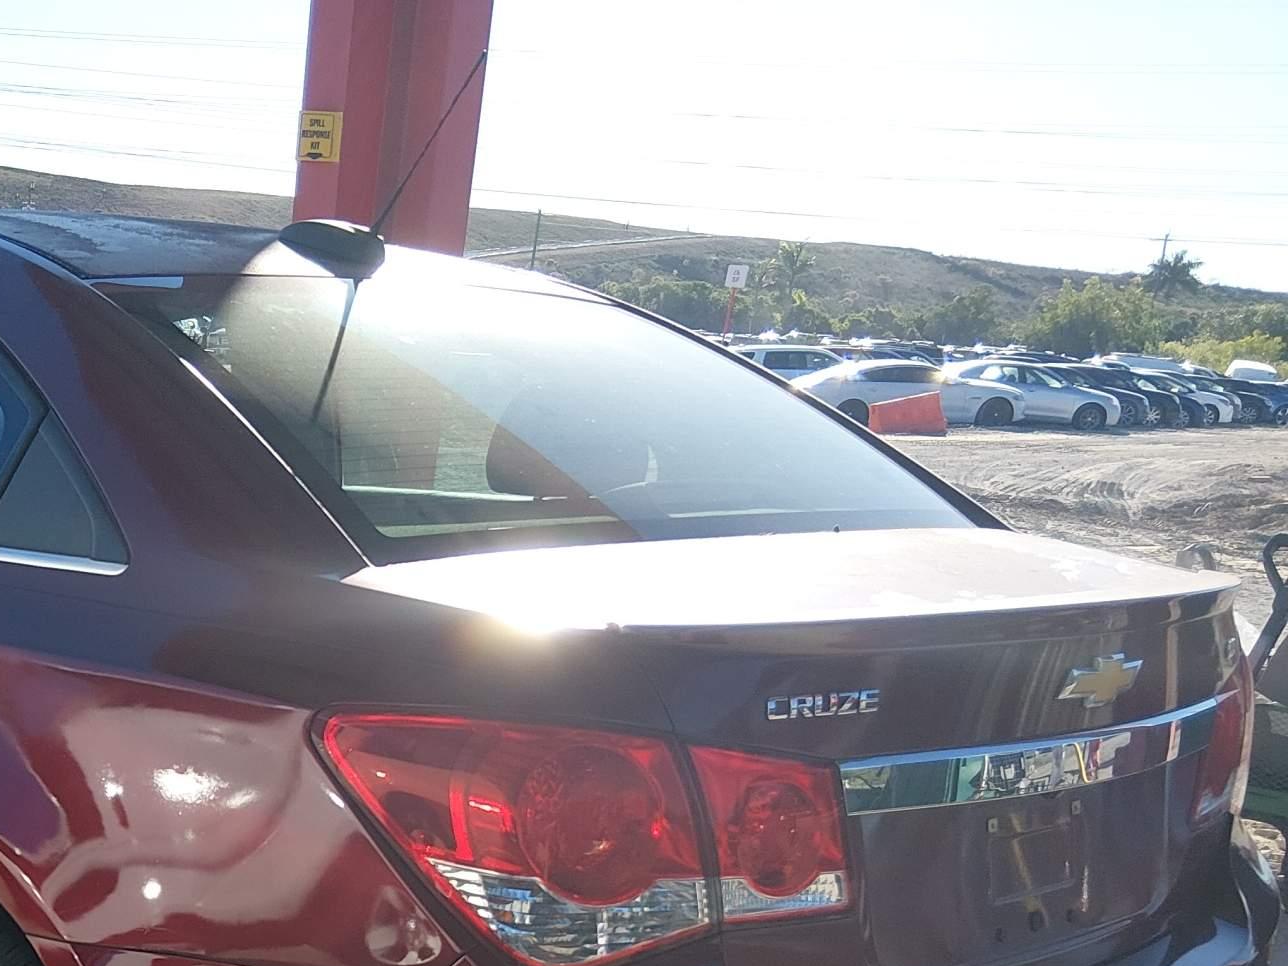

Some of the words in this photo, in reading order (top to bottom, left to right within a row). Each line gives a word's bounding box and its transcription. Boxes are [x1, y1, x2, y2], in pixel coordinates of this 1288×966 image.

[309, 118, 325, 128] SPILL
[302, 129, 331, 139] RESPONSE
[310, 141, 321, 150] KIT
[766, 688, 881, 721] CRUZE
